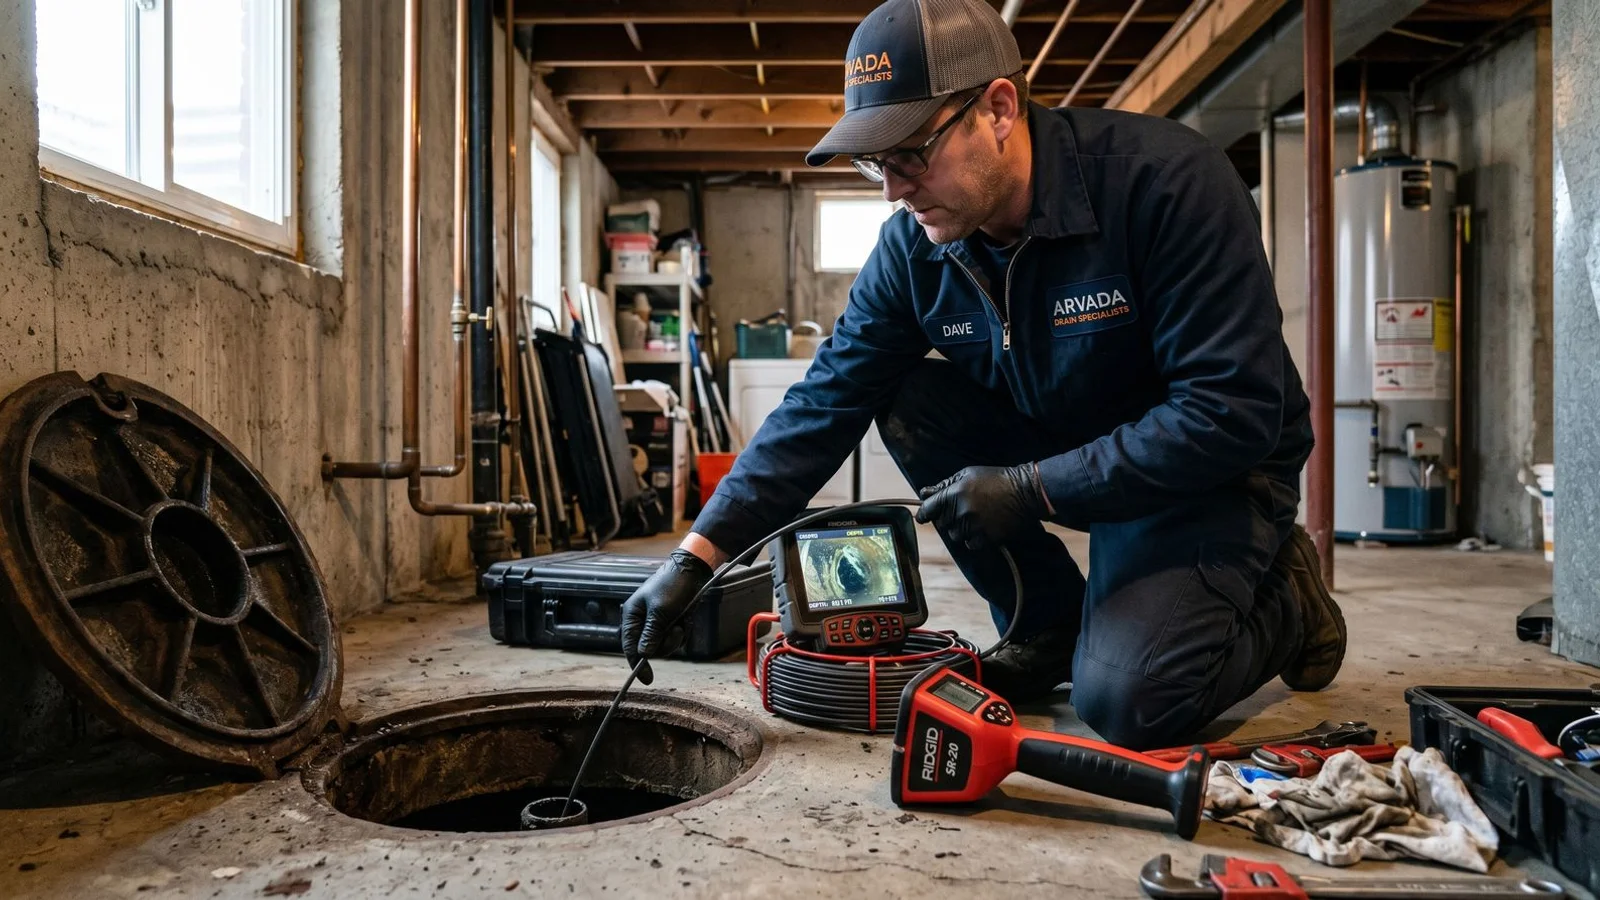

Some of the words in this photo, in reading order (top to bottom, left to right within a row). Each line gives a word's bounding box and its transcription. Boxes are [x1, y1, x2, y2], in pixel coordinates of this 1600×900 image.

[848, 71, 893, 87] SPECIALISTS
[1053, 288, 1127, 316] ARVADA
[1054, 314, 1078, 327] DRAIN
[1078, 305, 1131, 324] SPECIALISTS
[942, 322, 974, 337] DAVE
[921, 727, 939, 782] RIDGID
[945, 742, 960, 777] SR-20
